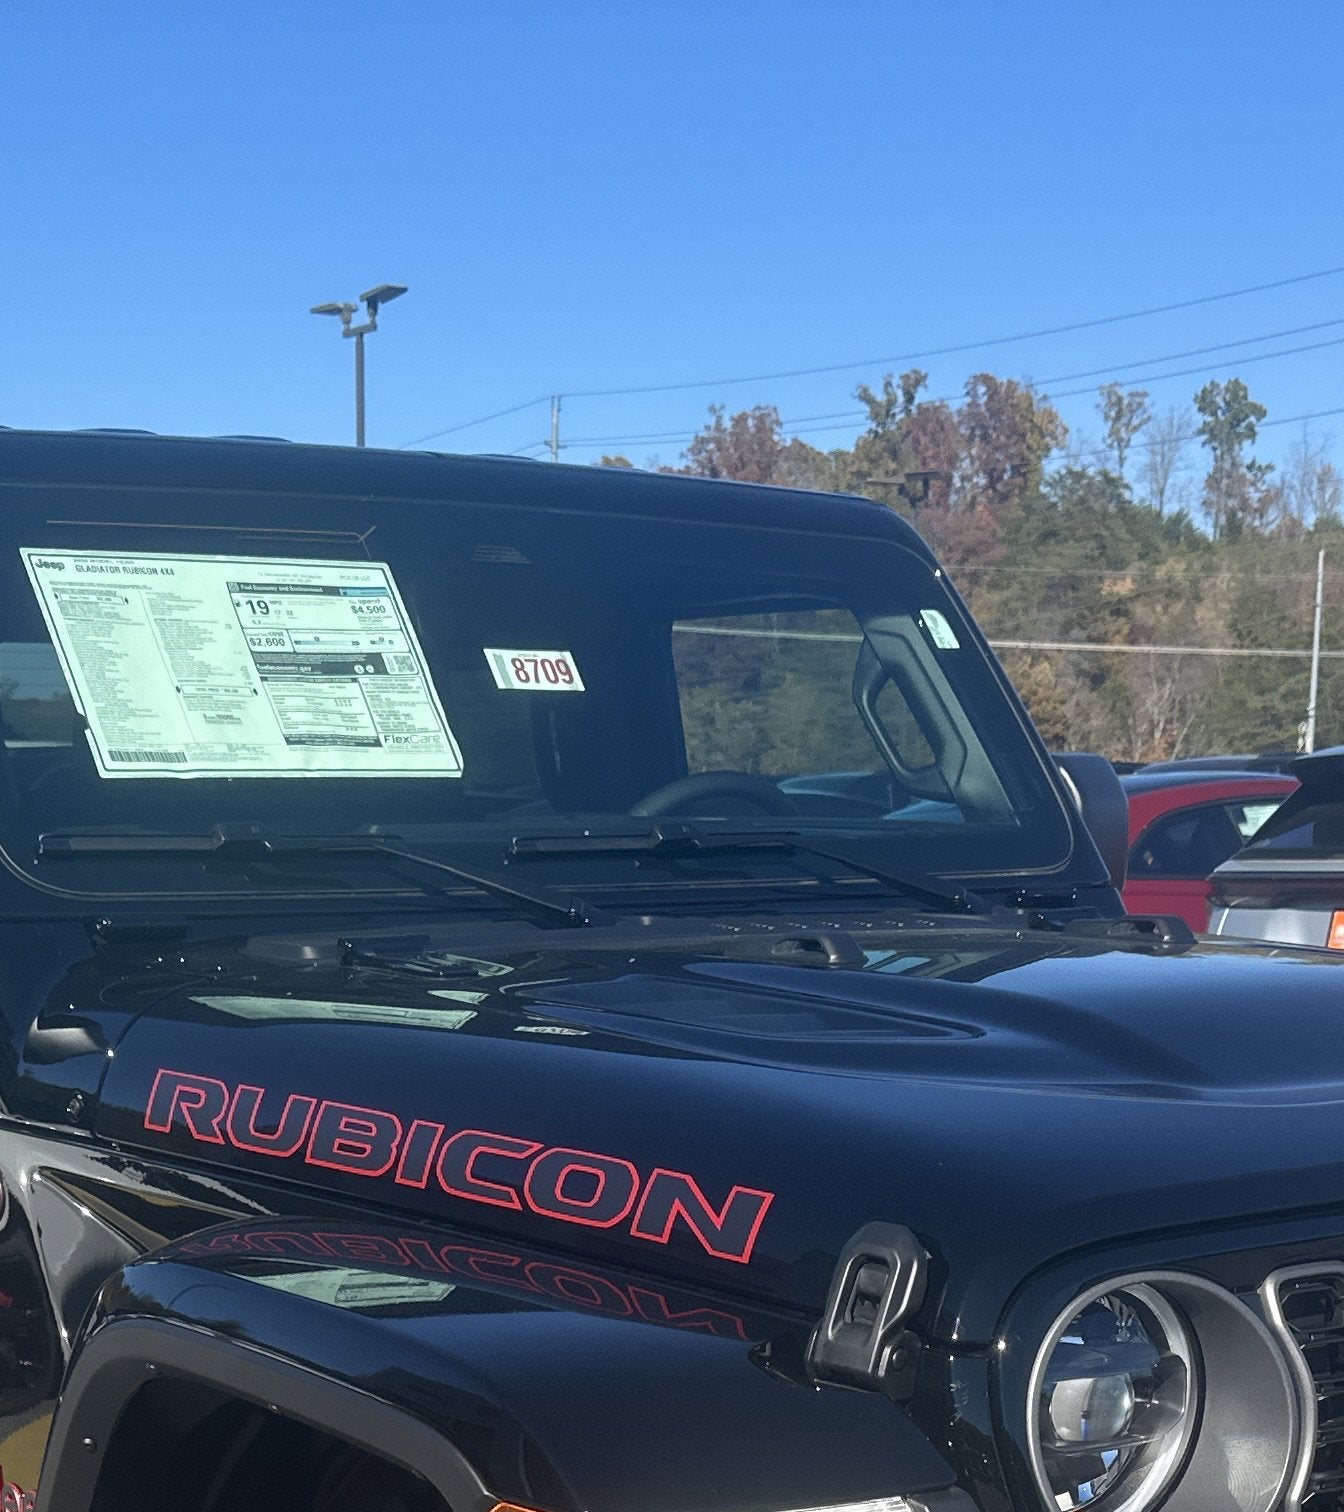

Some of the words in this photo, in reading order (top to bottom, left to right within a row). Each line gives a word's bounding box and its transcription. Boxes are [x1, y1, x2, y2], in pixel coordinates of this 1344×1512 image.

[35, 558, 65, 571] Jeep
[75, 564, 121, 574] GLADIATOR
[122, 566, 158, 576] RUBICON
[159, 567, 175, 576] 4X4
[246, 600, 269, 615] 19
[249, 637, 285, 647] $2,600
[511, 658, 574, 684] 8709
[384, 734, 441, 745] FlexCare
[143, 1068, 775, 1264] RUBICON
